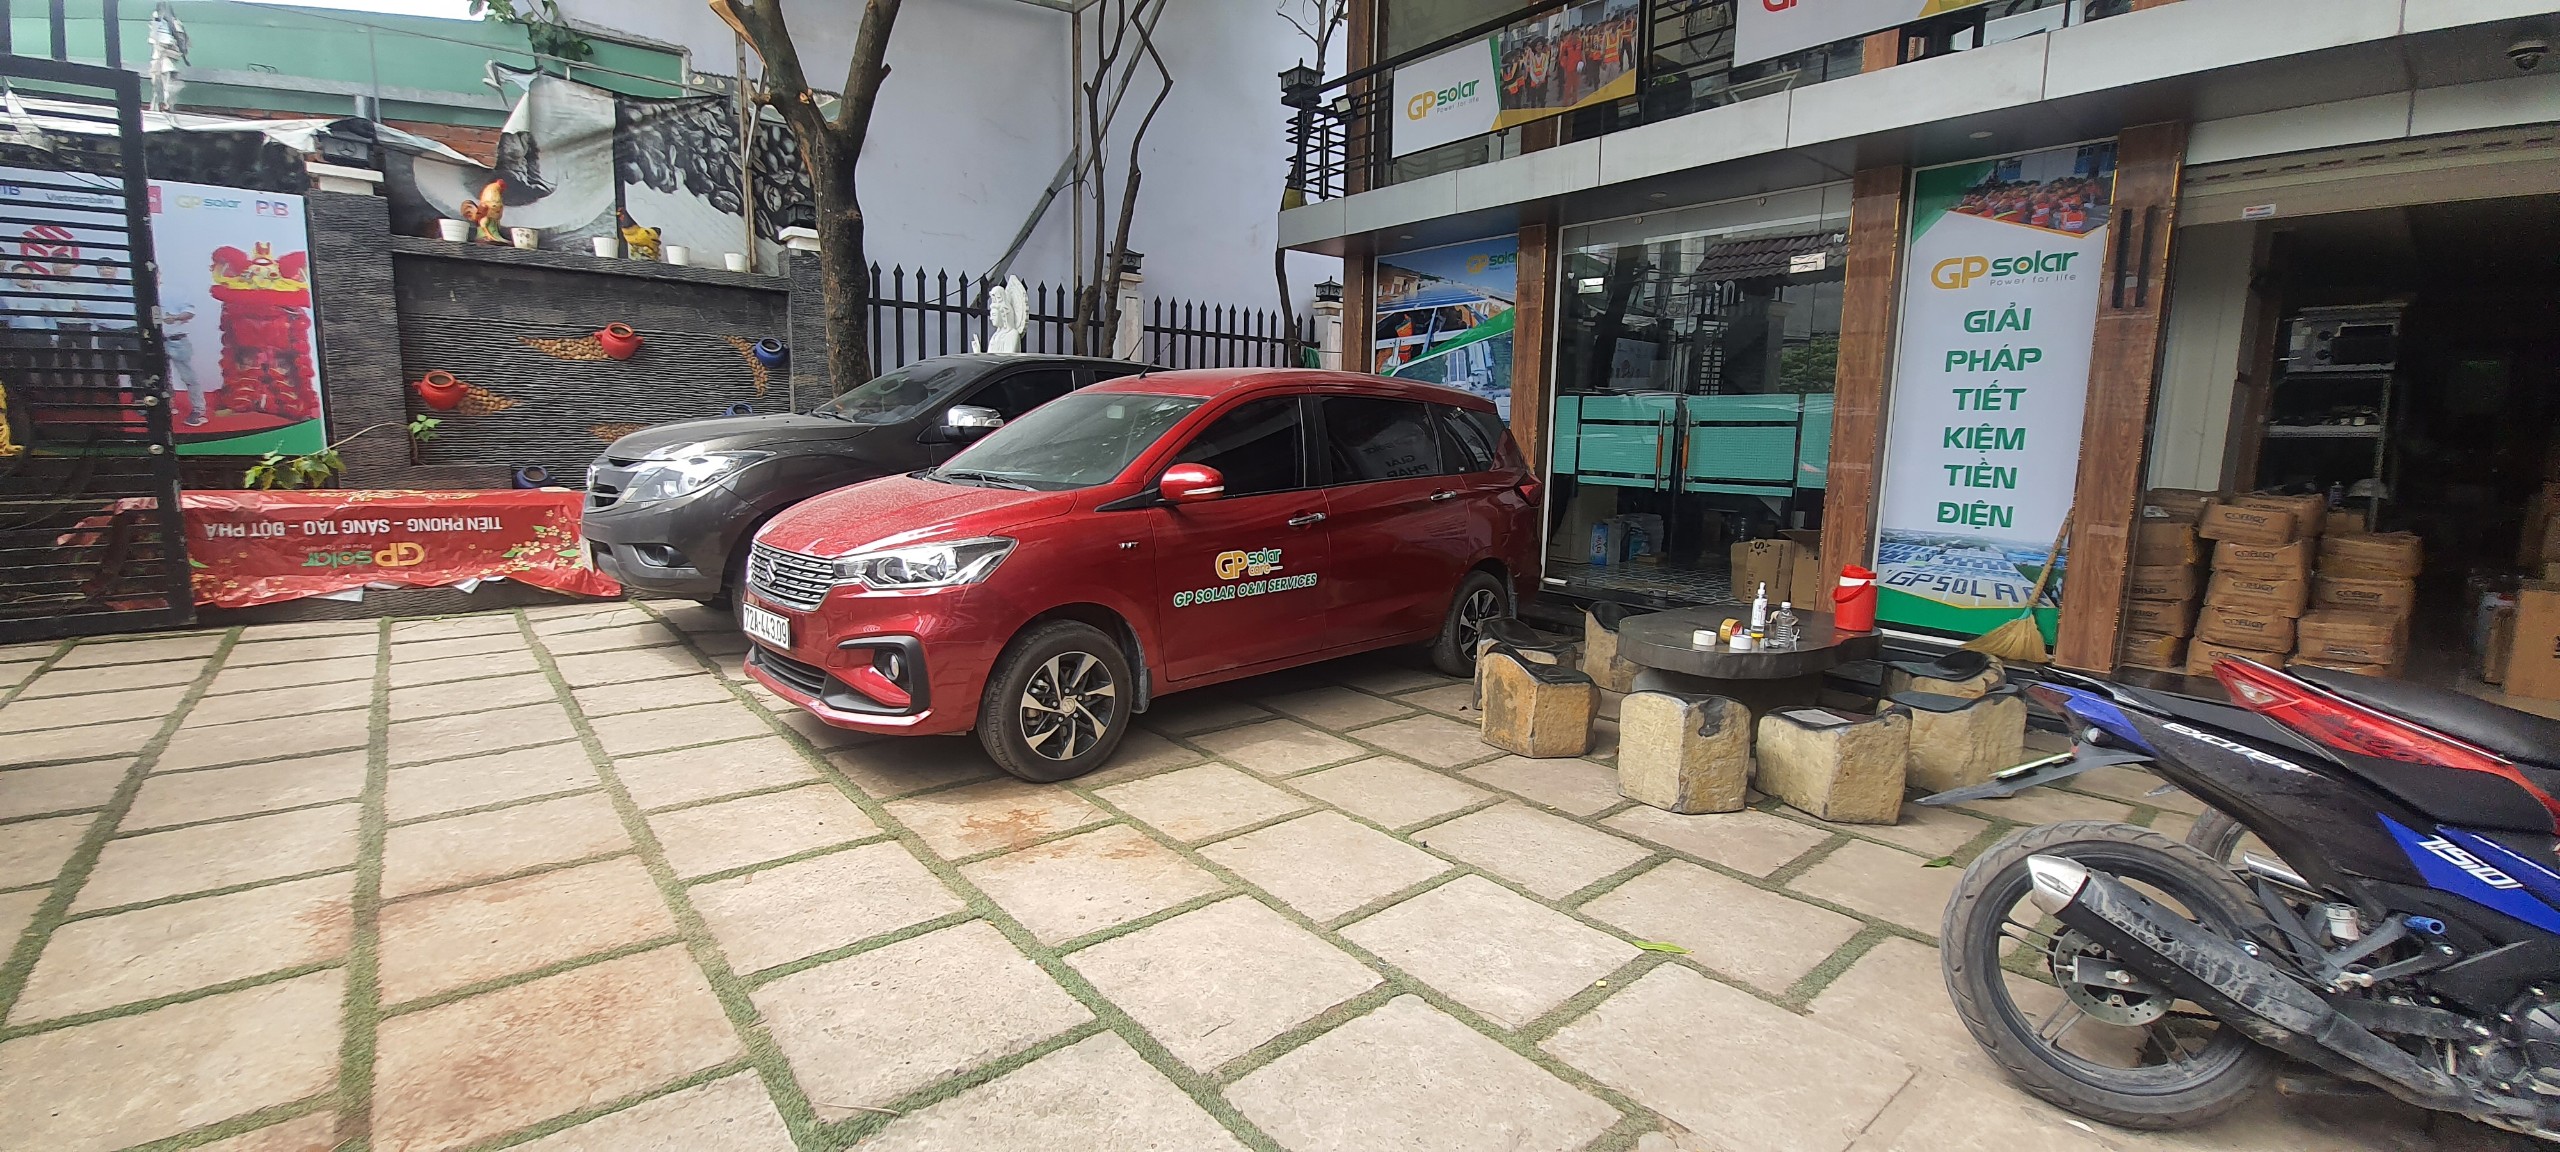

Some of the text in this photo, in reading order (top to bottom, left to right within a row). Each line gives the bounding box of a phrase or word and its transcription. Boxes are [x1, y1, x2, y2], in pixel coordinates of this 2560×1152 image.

[1408, 80, 1480, 120] GP solar
[1931, 250, 2079, 290] GP solar
[1990, 278, 2025, 287] Power
[1964, 302, 2032, 333] GIẢI
[1945, 344, 2042, 372] PHÁP
[1953, 380, 2027, 411] TIẾT
[1943, 423, 2026, 453] KIỆM
[1944, 457, 2017, 489] TIỀN
[303, 516, 338, 535] TẠO
[341, 518, 390, 535] SÁNG
[407, 517, 464, 532] PHONG
[468, 516, 503, 531] TIÊN
[1937, 500, 2014, 529] ĐIỆN
[301, 542, 425, 568] GP solar
[1215, 547, 1282, 580] GP solar
[1248, 563, 1271, 576] care
[1174, 573, 1318, 607] GP SOLAR O&M SERVICES
[2162, 722, 2300, 771] EXCITER
